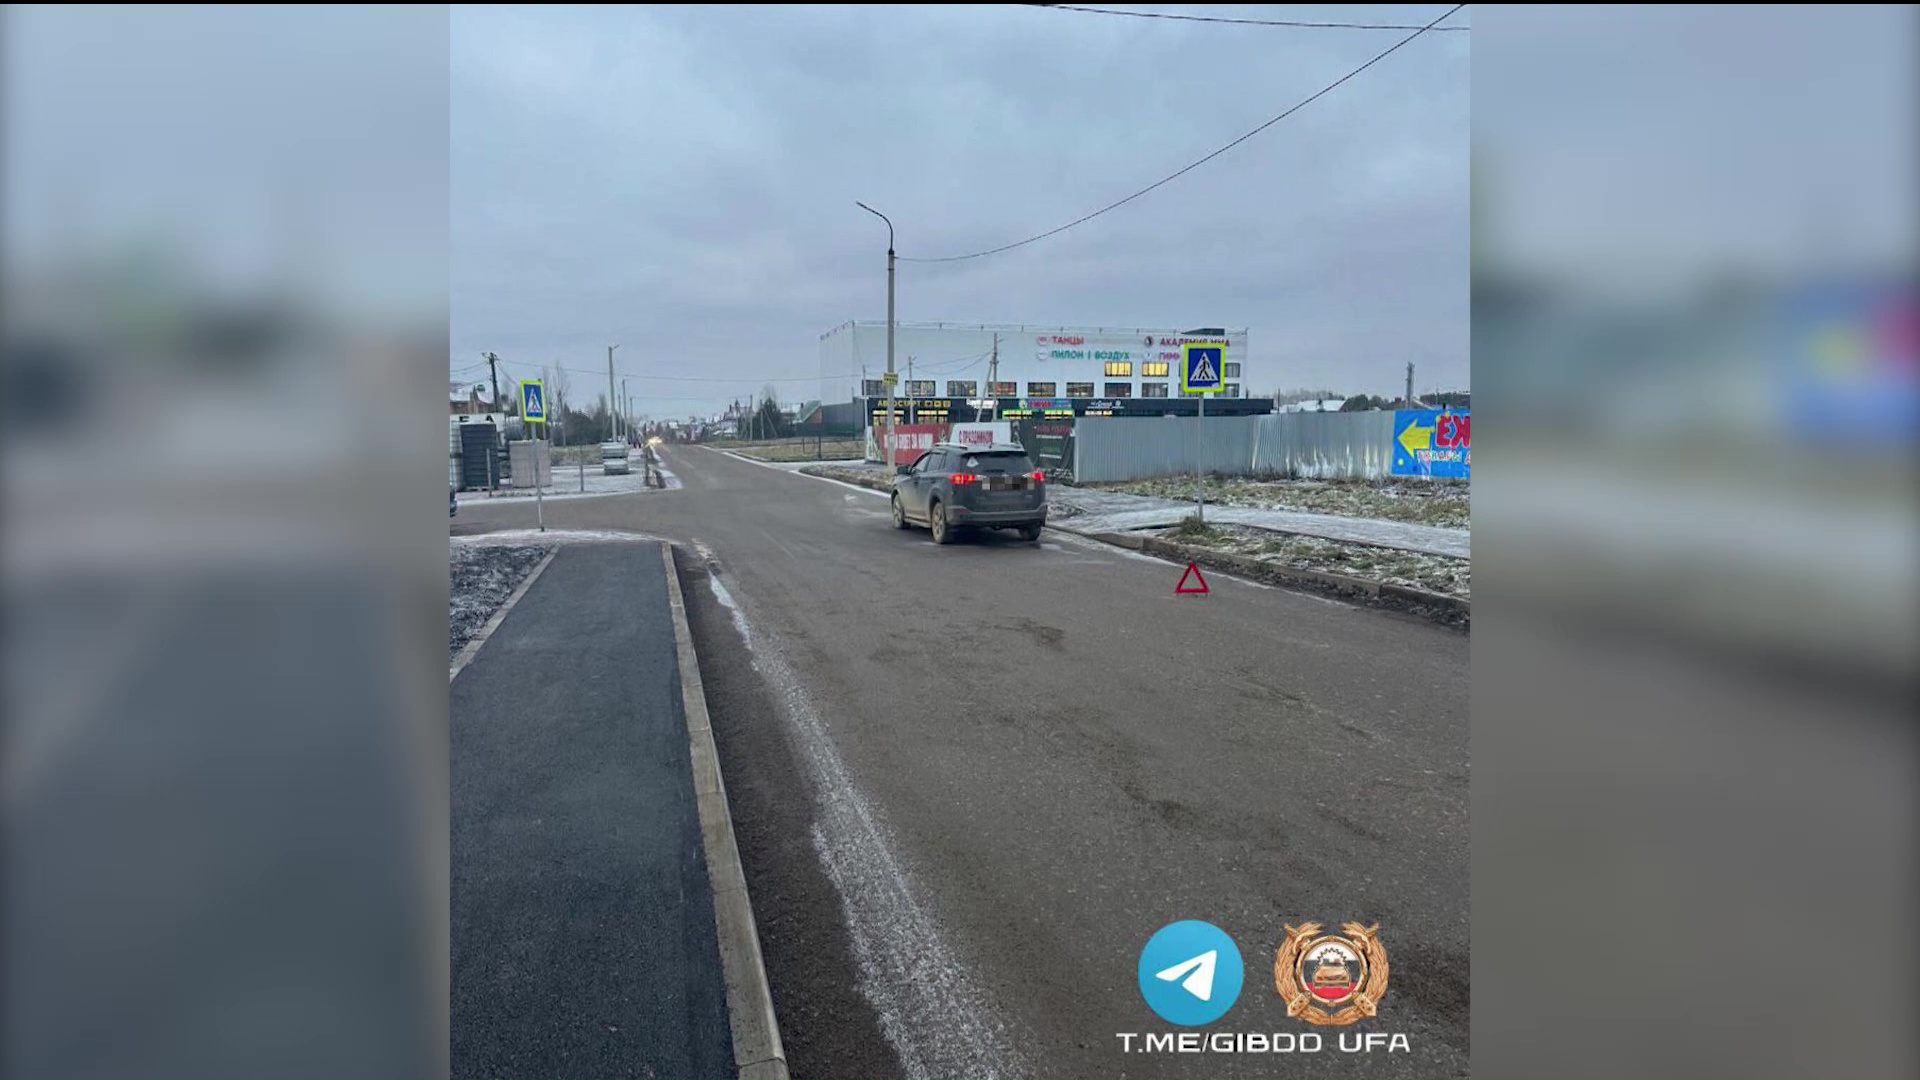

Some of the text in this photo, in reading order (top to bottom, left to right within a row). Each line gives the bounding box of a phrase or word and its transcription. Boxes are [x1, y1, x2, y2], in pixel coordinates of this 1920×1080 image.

[1052, 336, 1084, 346] ТАНЦЫ
[1051, 350, 1084, 359] ПИЛОН
[1095, 350, 1130, 360] ВОЗДУХ
